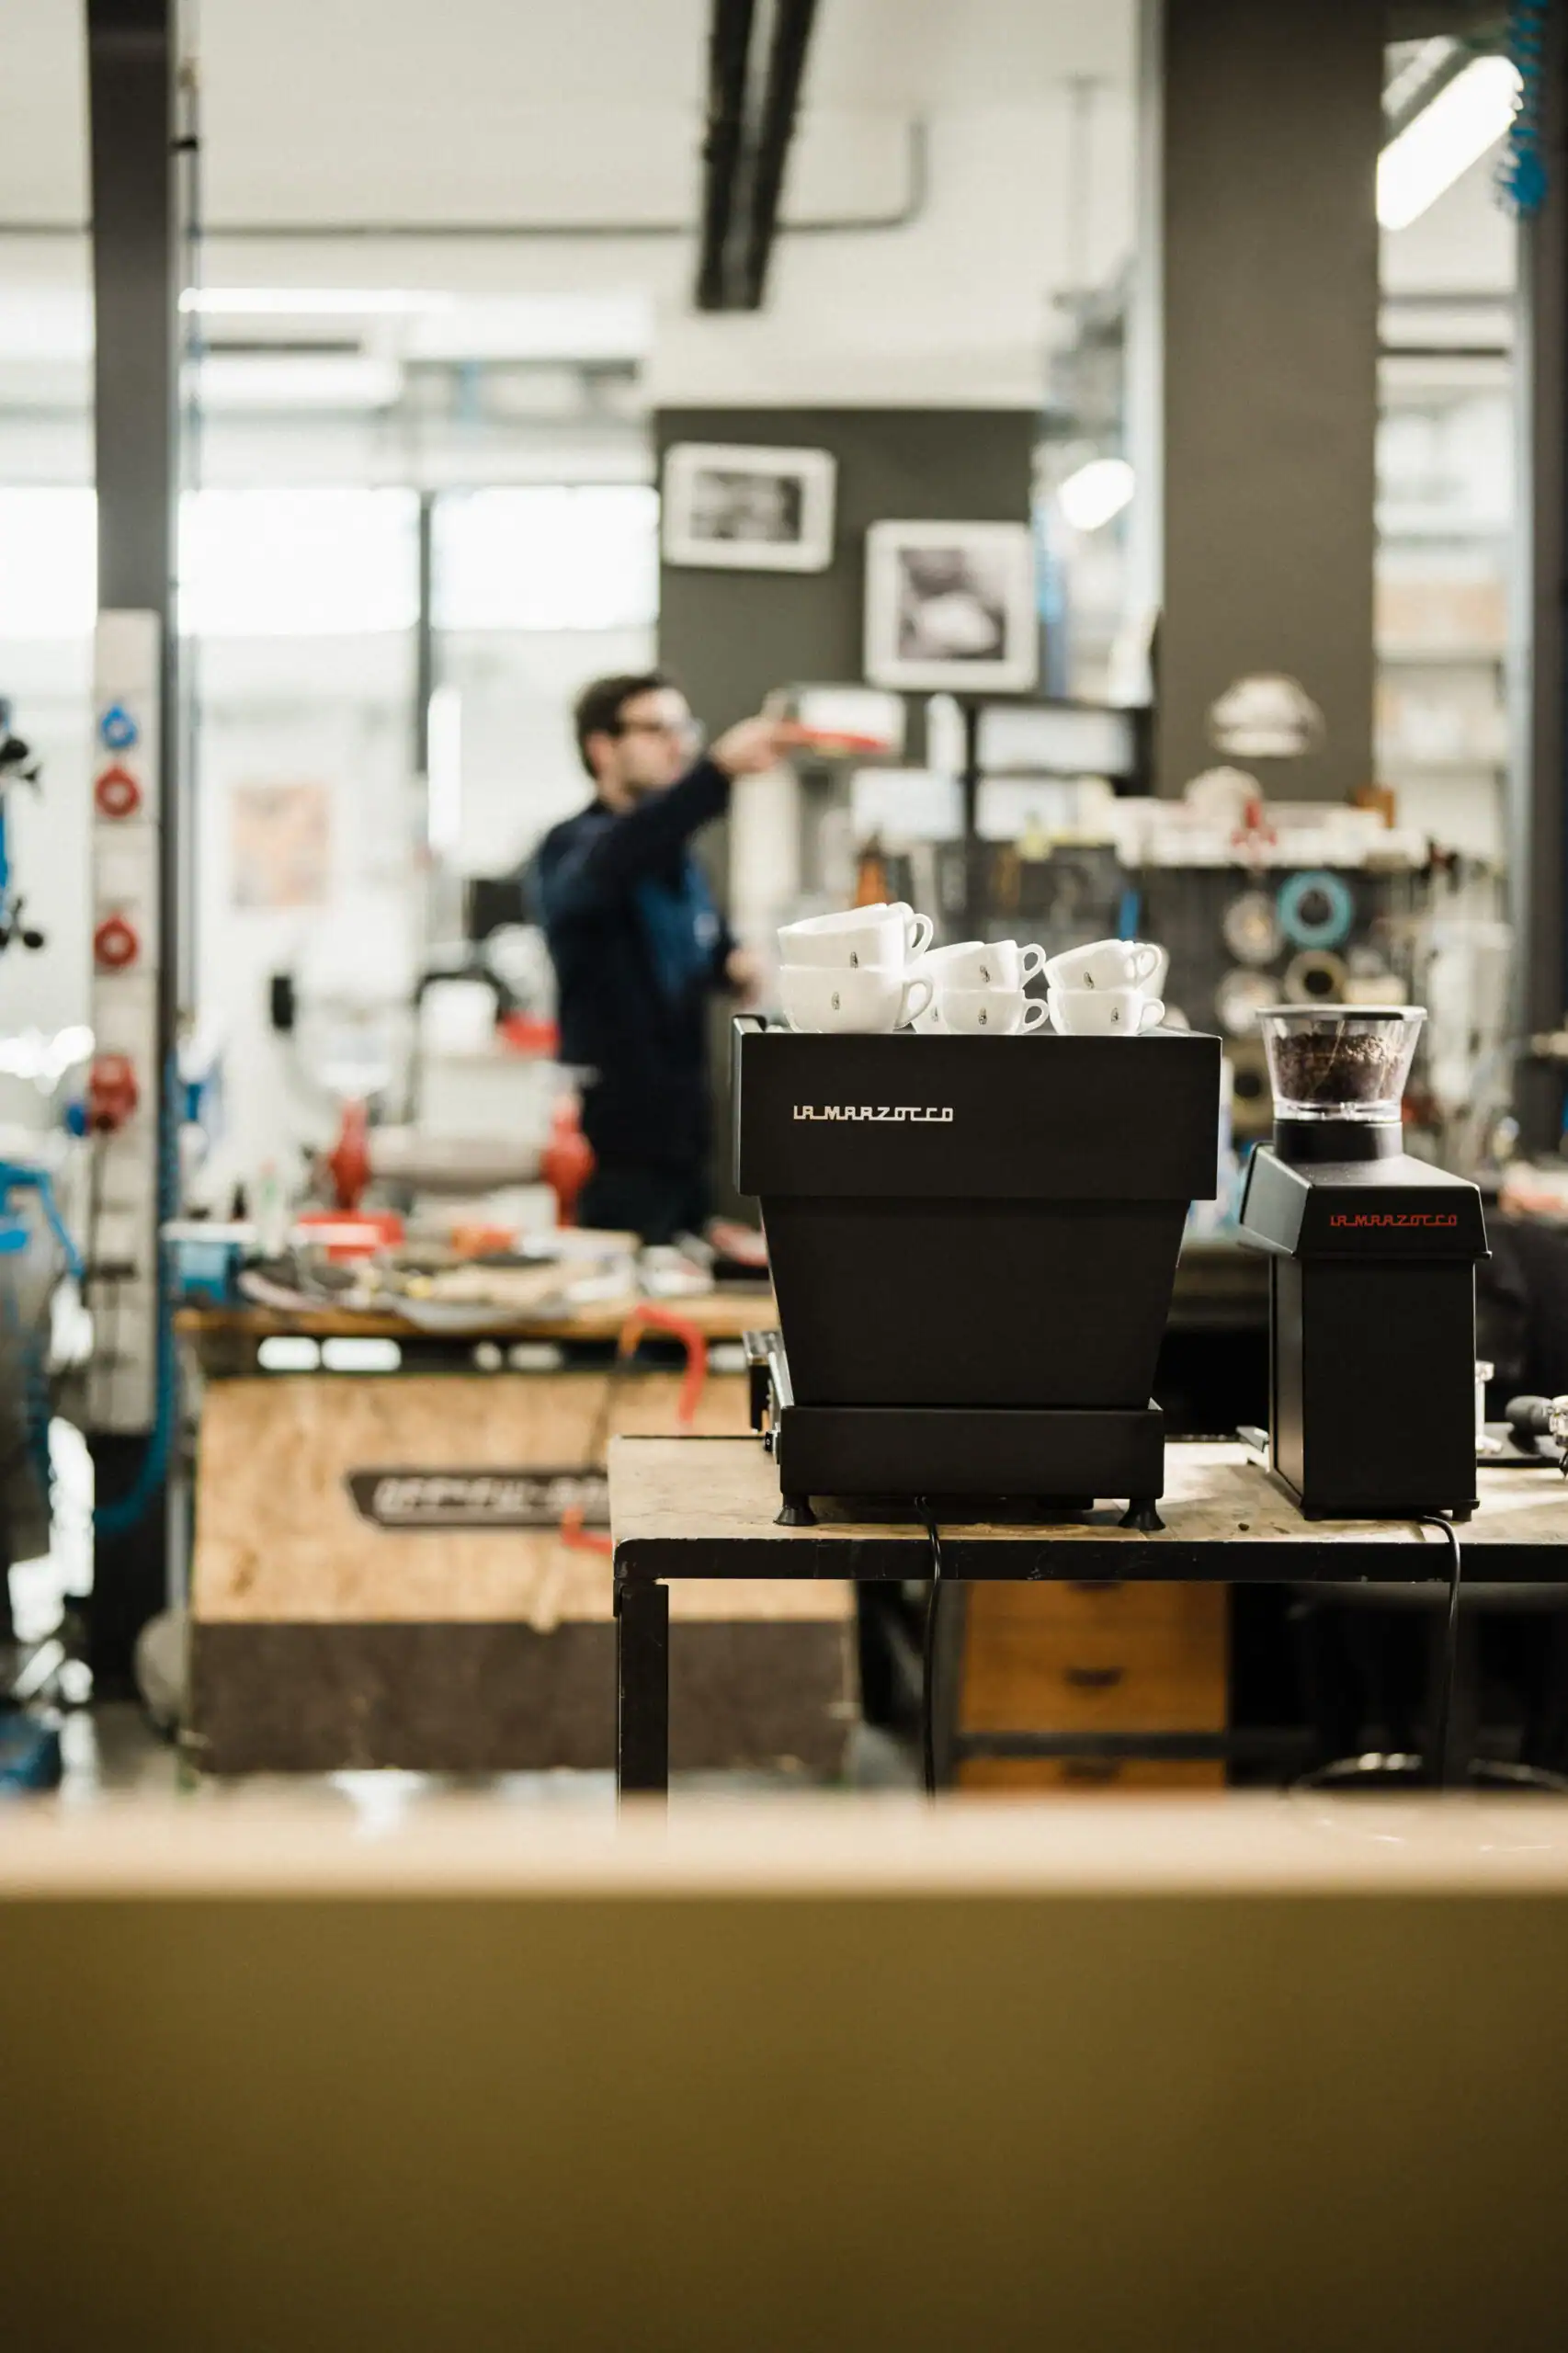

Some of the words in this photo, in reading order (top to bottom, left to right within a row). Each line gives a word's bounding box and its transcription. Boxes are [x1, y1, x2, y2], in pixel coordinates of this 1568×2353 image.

[793, 1106, 813, 1120] LA
[824, 1106, 953, 1121] MARZOCCO
[1330, 1214, 1346, 1226] LA
[1355, 1214, 1457, 1226] MARZOCCO
